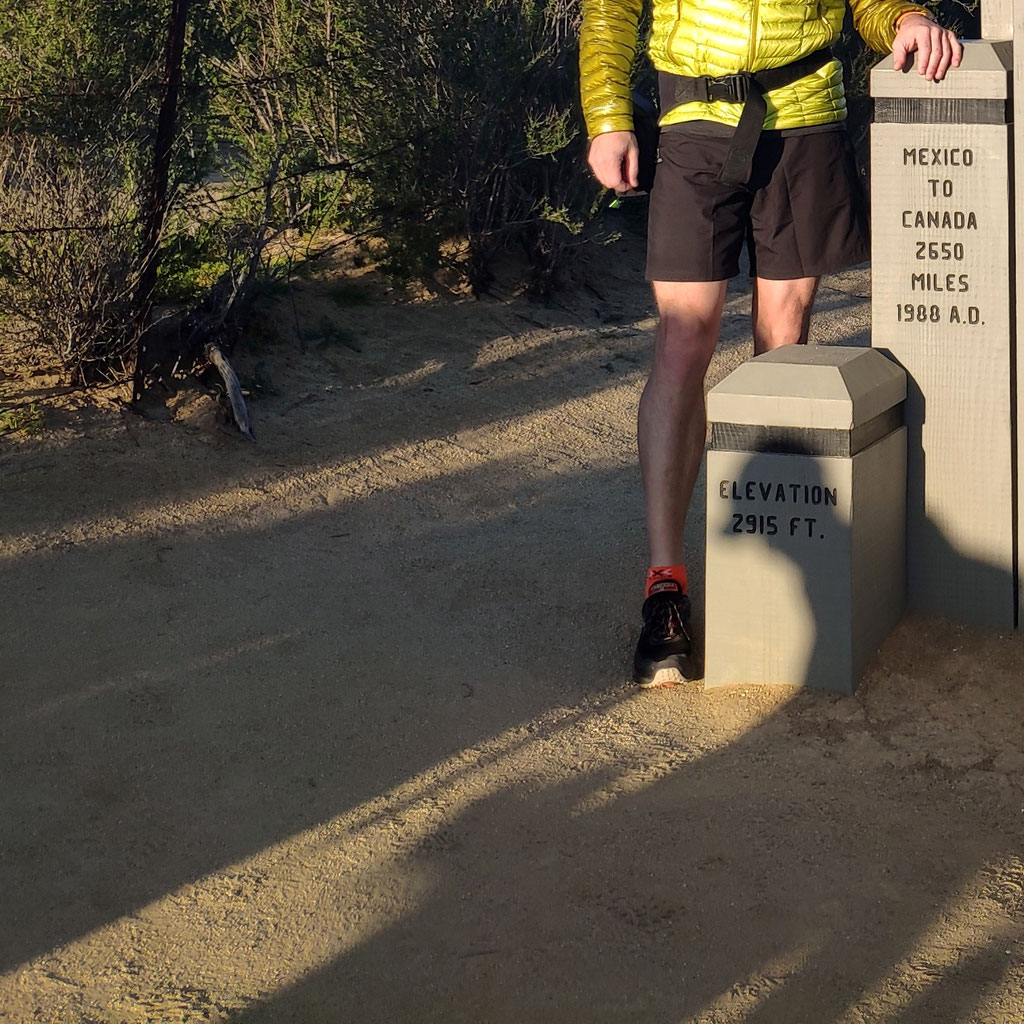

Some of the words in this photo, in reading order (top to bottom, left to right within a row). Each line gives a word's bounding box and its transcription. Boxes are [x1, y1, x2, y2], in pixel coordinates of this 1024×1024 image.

[903, 147, 974, 166] MEXICO
[927, 179, 953, 198] TO
[902, 210, 978, 230] CANADA
[915, 241, 965, 261] 2650
[911, 272, 969, 292] MILES
[897, 303, 941, 323] 1988
[949, 305, 985, 325] A.D.
[719, 480, 838, 506] ELEVATION
[732, 513, 778, 536] 2915
[789, 517, 825, 539] FT.
